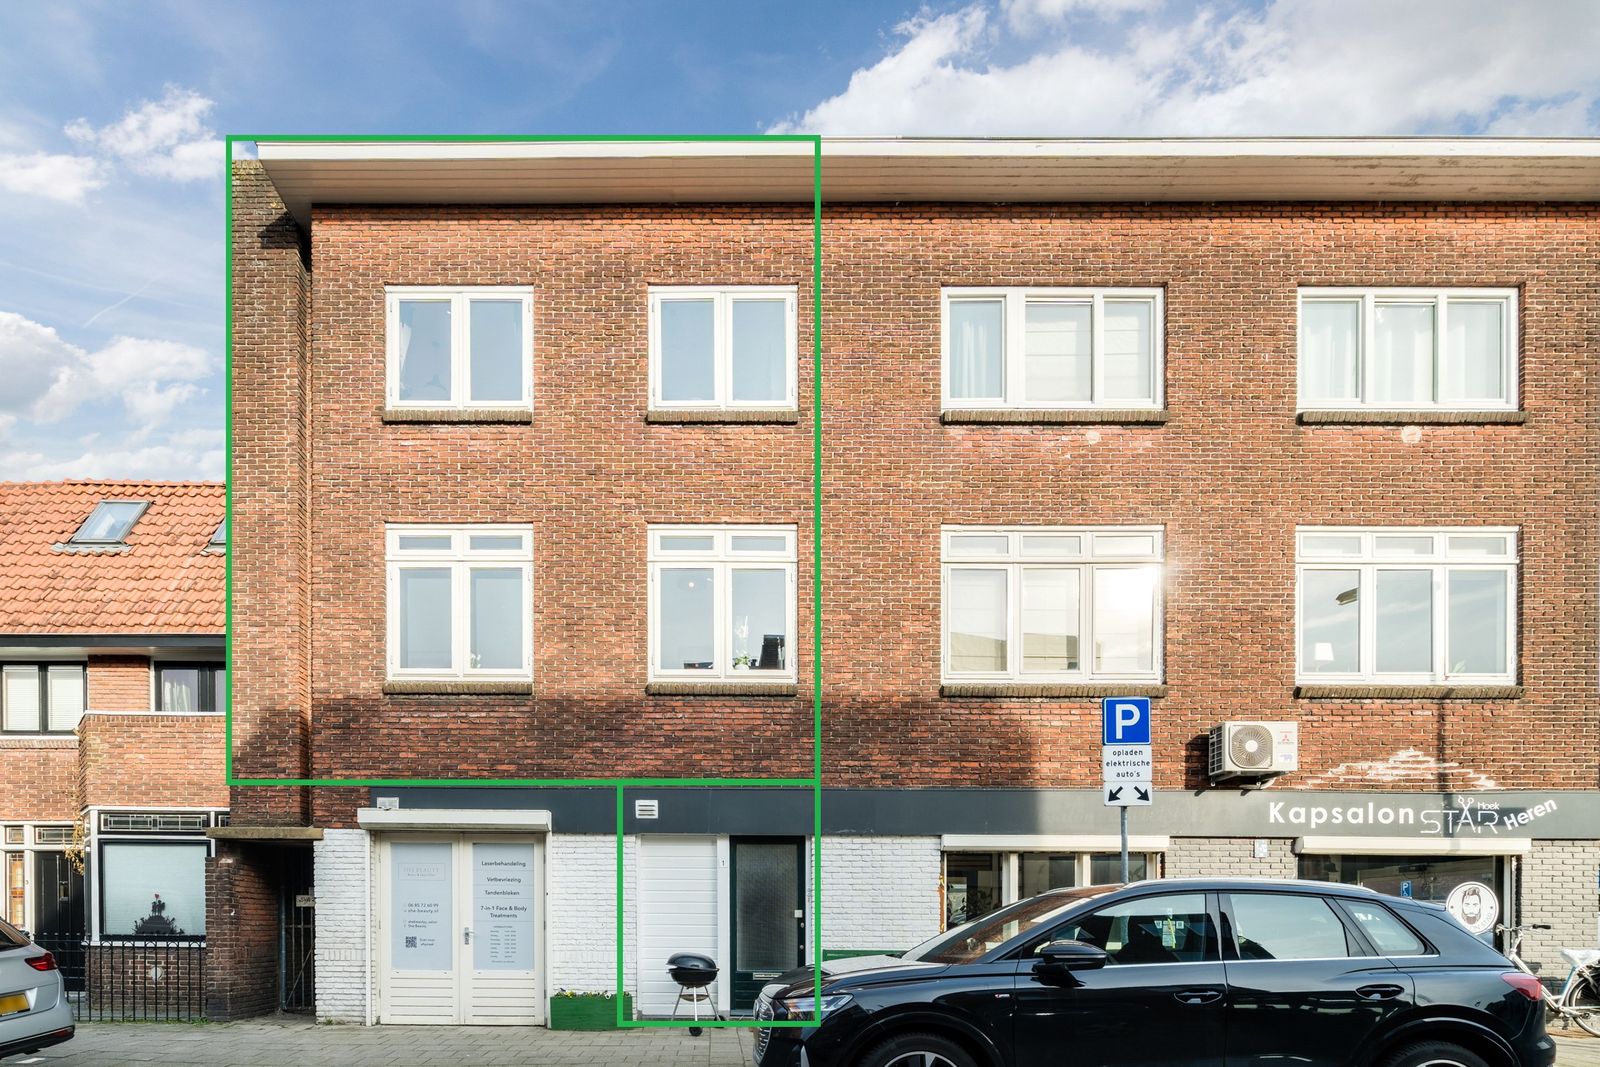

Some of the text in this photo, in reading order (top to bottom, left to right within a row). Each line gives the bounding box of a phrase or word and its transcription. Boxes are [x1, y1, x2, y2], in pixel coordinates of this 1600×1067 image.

[1115, 703, 1141, 740] P
[1112, 749, 1144, 757] opladen
[1105, 759, 1151, 767] elektrische
[1115, 770, 1141, 778] auto's
[1477, 801, 1500, 810] Hoek
[1269, 798, 1558, 834] Kapsalon STAR Heren
